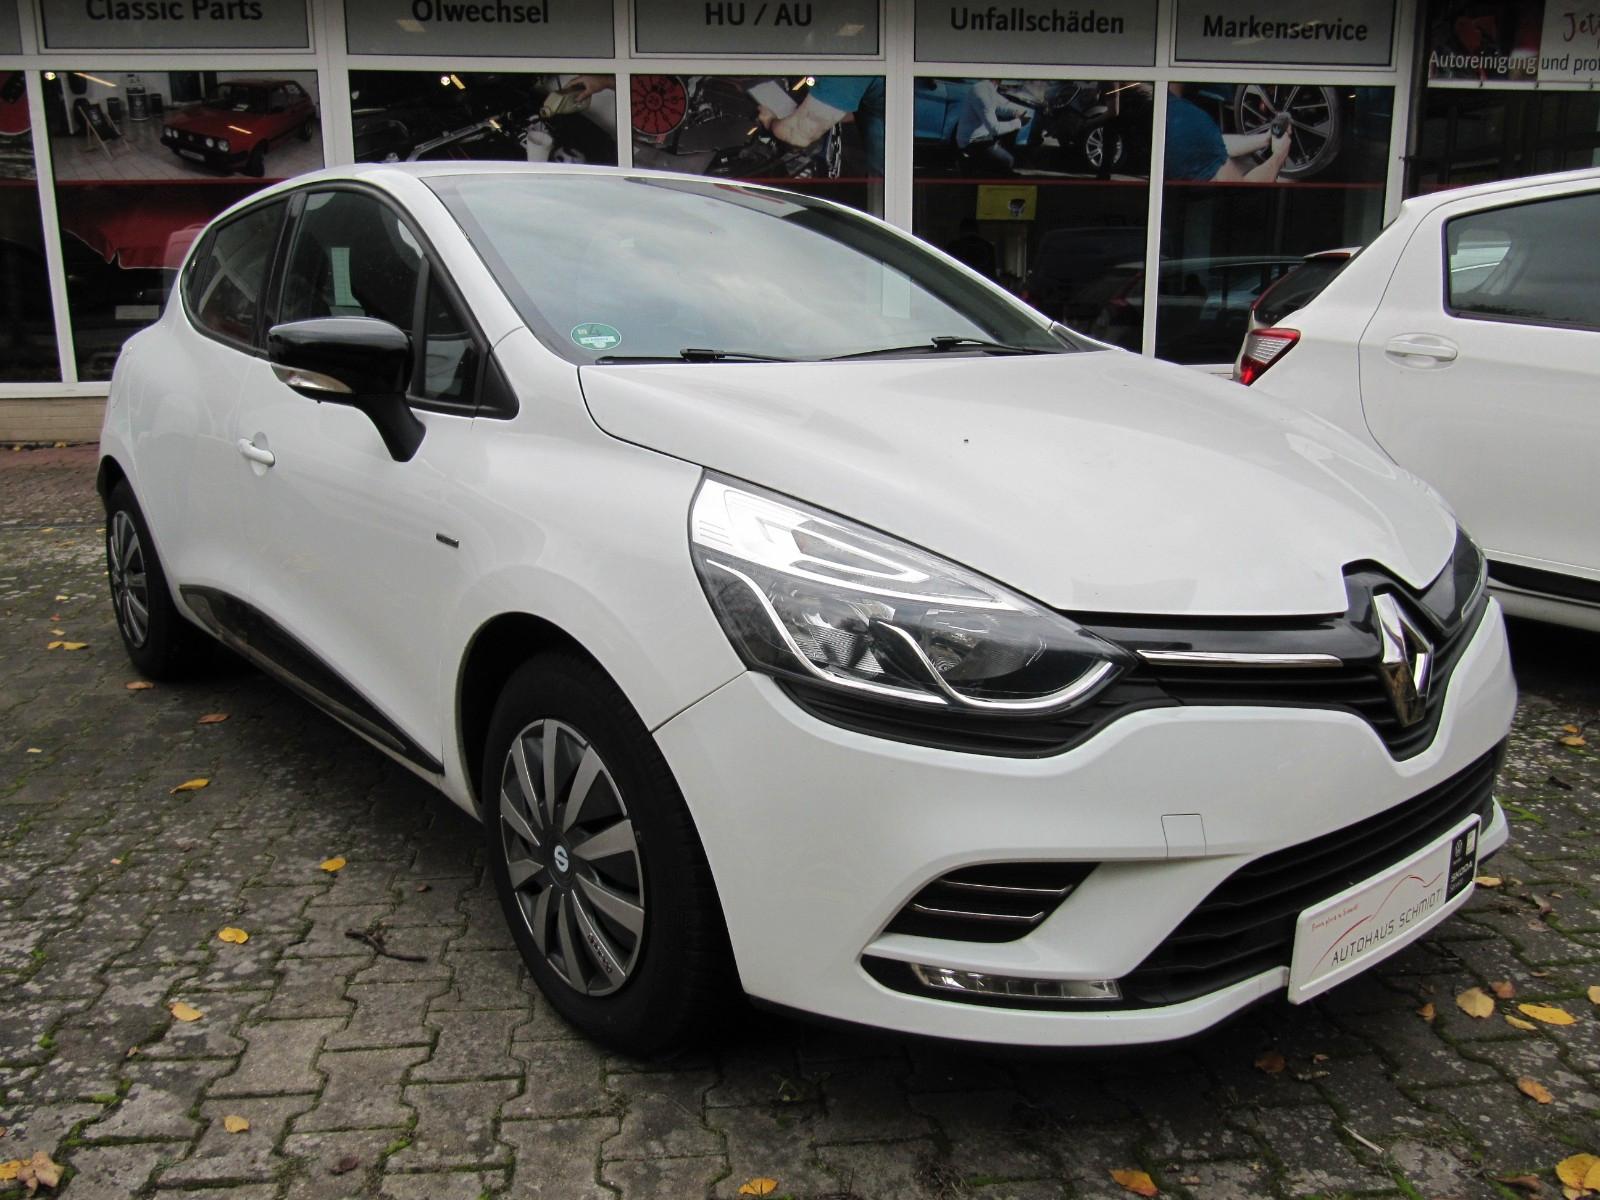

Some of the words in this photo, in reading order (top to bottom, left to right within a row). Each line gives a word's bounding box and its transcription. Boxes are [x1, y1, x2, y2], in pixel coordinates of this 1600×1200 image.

[86, 0, 184, 21] Classic
[193, 0, 264, 21] Parts
[705, 2, 746, 26] HU
[753, 3, 767, 26] /
[774, 2, 813, 27] AU
[950, 7, 1124, 35] Unfallschäden
[1203, 14, 1369, 42] Markenservice
[1562, 11, 1600, 43] Jet
[1428, 50, 1538, 74] Autoreinigung
[1541, 53, 1570, 71] und
[1332, 919, 1395, 966] AUTOHAUS
[1399, 887, 1444, 929] SCHMIDT
